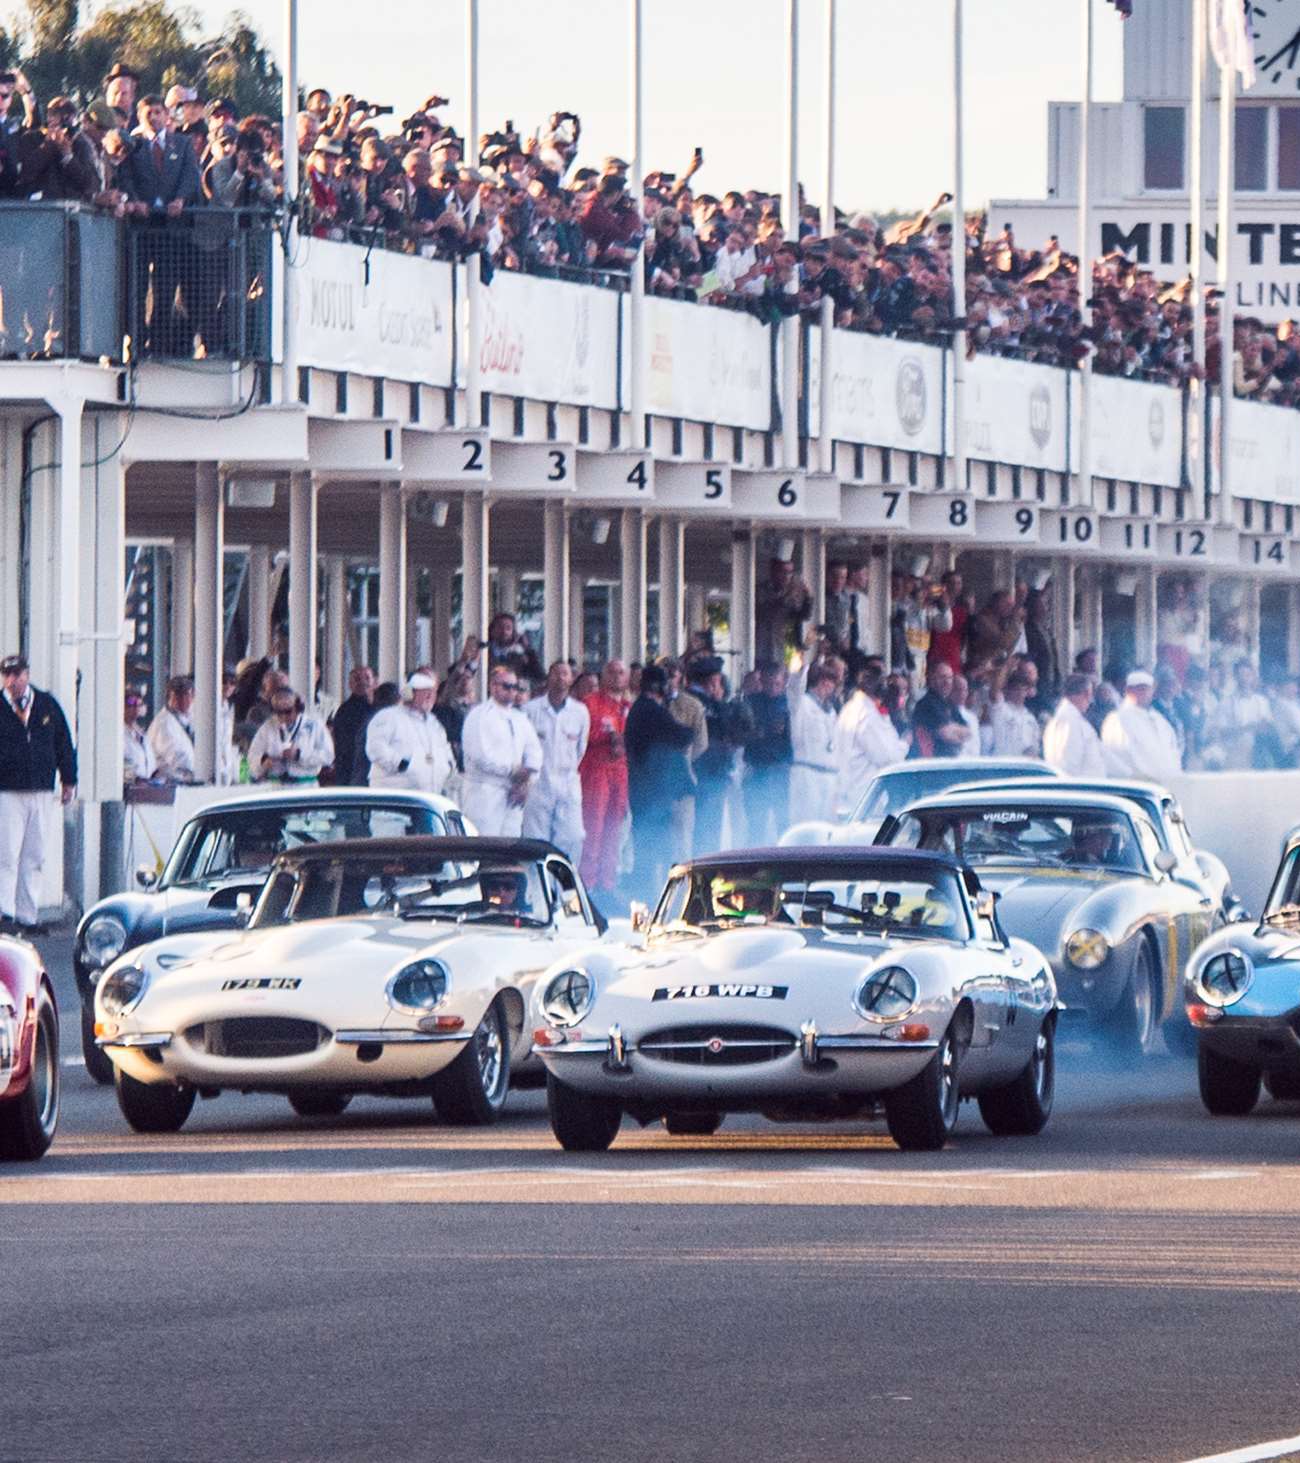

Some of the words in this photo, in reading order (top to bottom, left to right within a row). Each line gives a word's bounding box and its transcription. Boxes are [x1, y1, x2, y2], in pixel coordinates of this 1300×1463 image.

[384, 429, 393, 460] 1
[462, 440, 483, 471] 2
[547, 451, 567, 481] 3
[627, 461, 647, 490] 4
[704, 470, 723, 498] 5
[777, 479, 797, 507] 6
[882, 492, 901, 518] 7
[949, 500, 967, 526] 8
[1015, 508, 1033, 534] 9
[1060, 516, 1092, 542] 10
[1125, 524, 1150, 549] 11
[1175, 530, 1206, 556] 12
[1253, 540, 1285, 565] 14
[718, 984, 773, 998] WPB
